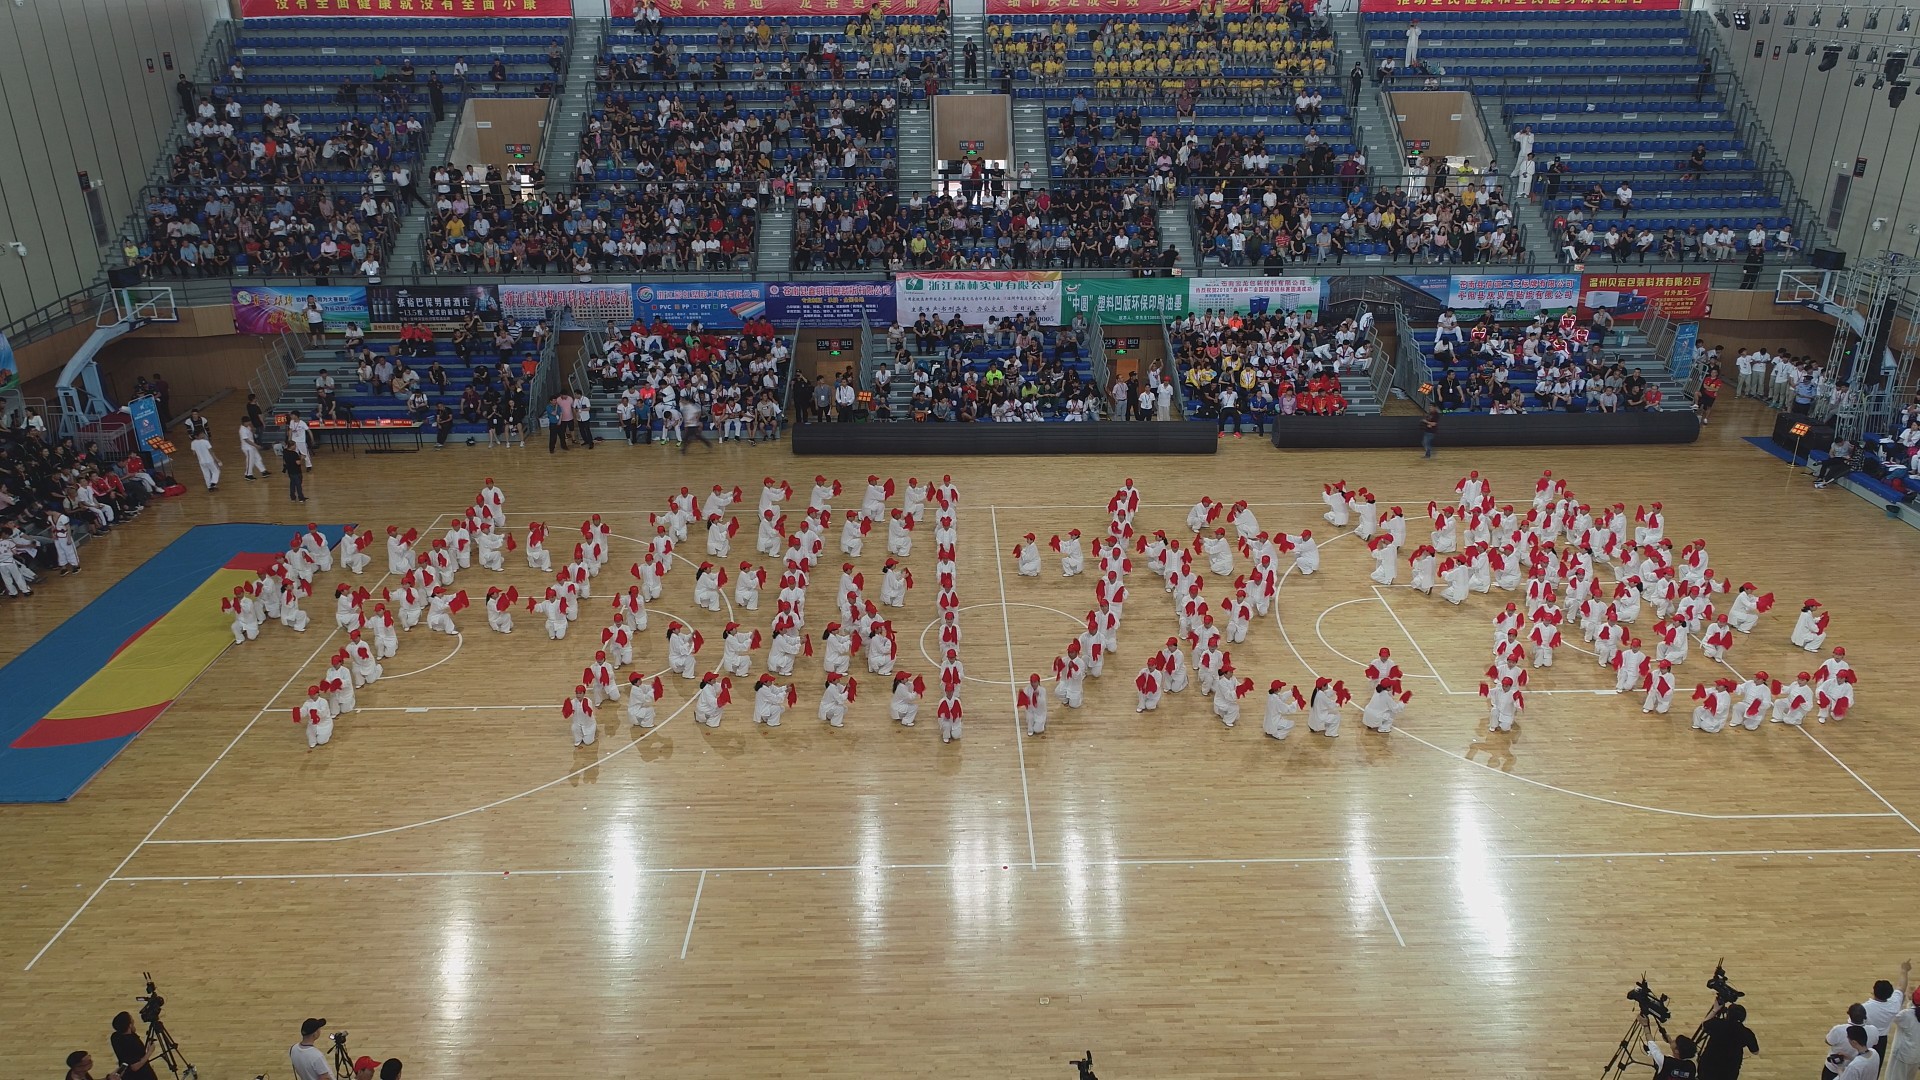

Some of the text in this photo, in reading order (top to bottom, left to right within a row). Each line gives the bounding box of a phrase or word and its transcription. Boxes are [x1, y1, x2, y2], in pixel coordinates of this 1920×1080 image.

[276, 0, 537, 10] 没有全面健康就没有全面小康
[638, 0, 763, 9] 圾不落地
[928, 280, 1054, 291] 浙江森林实业有限公司
